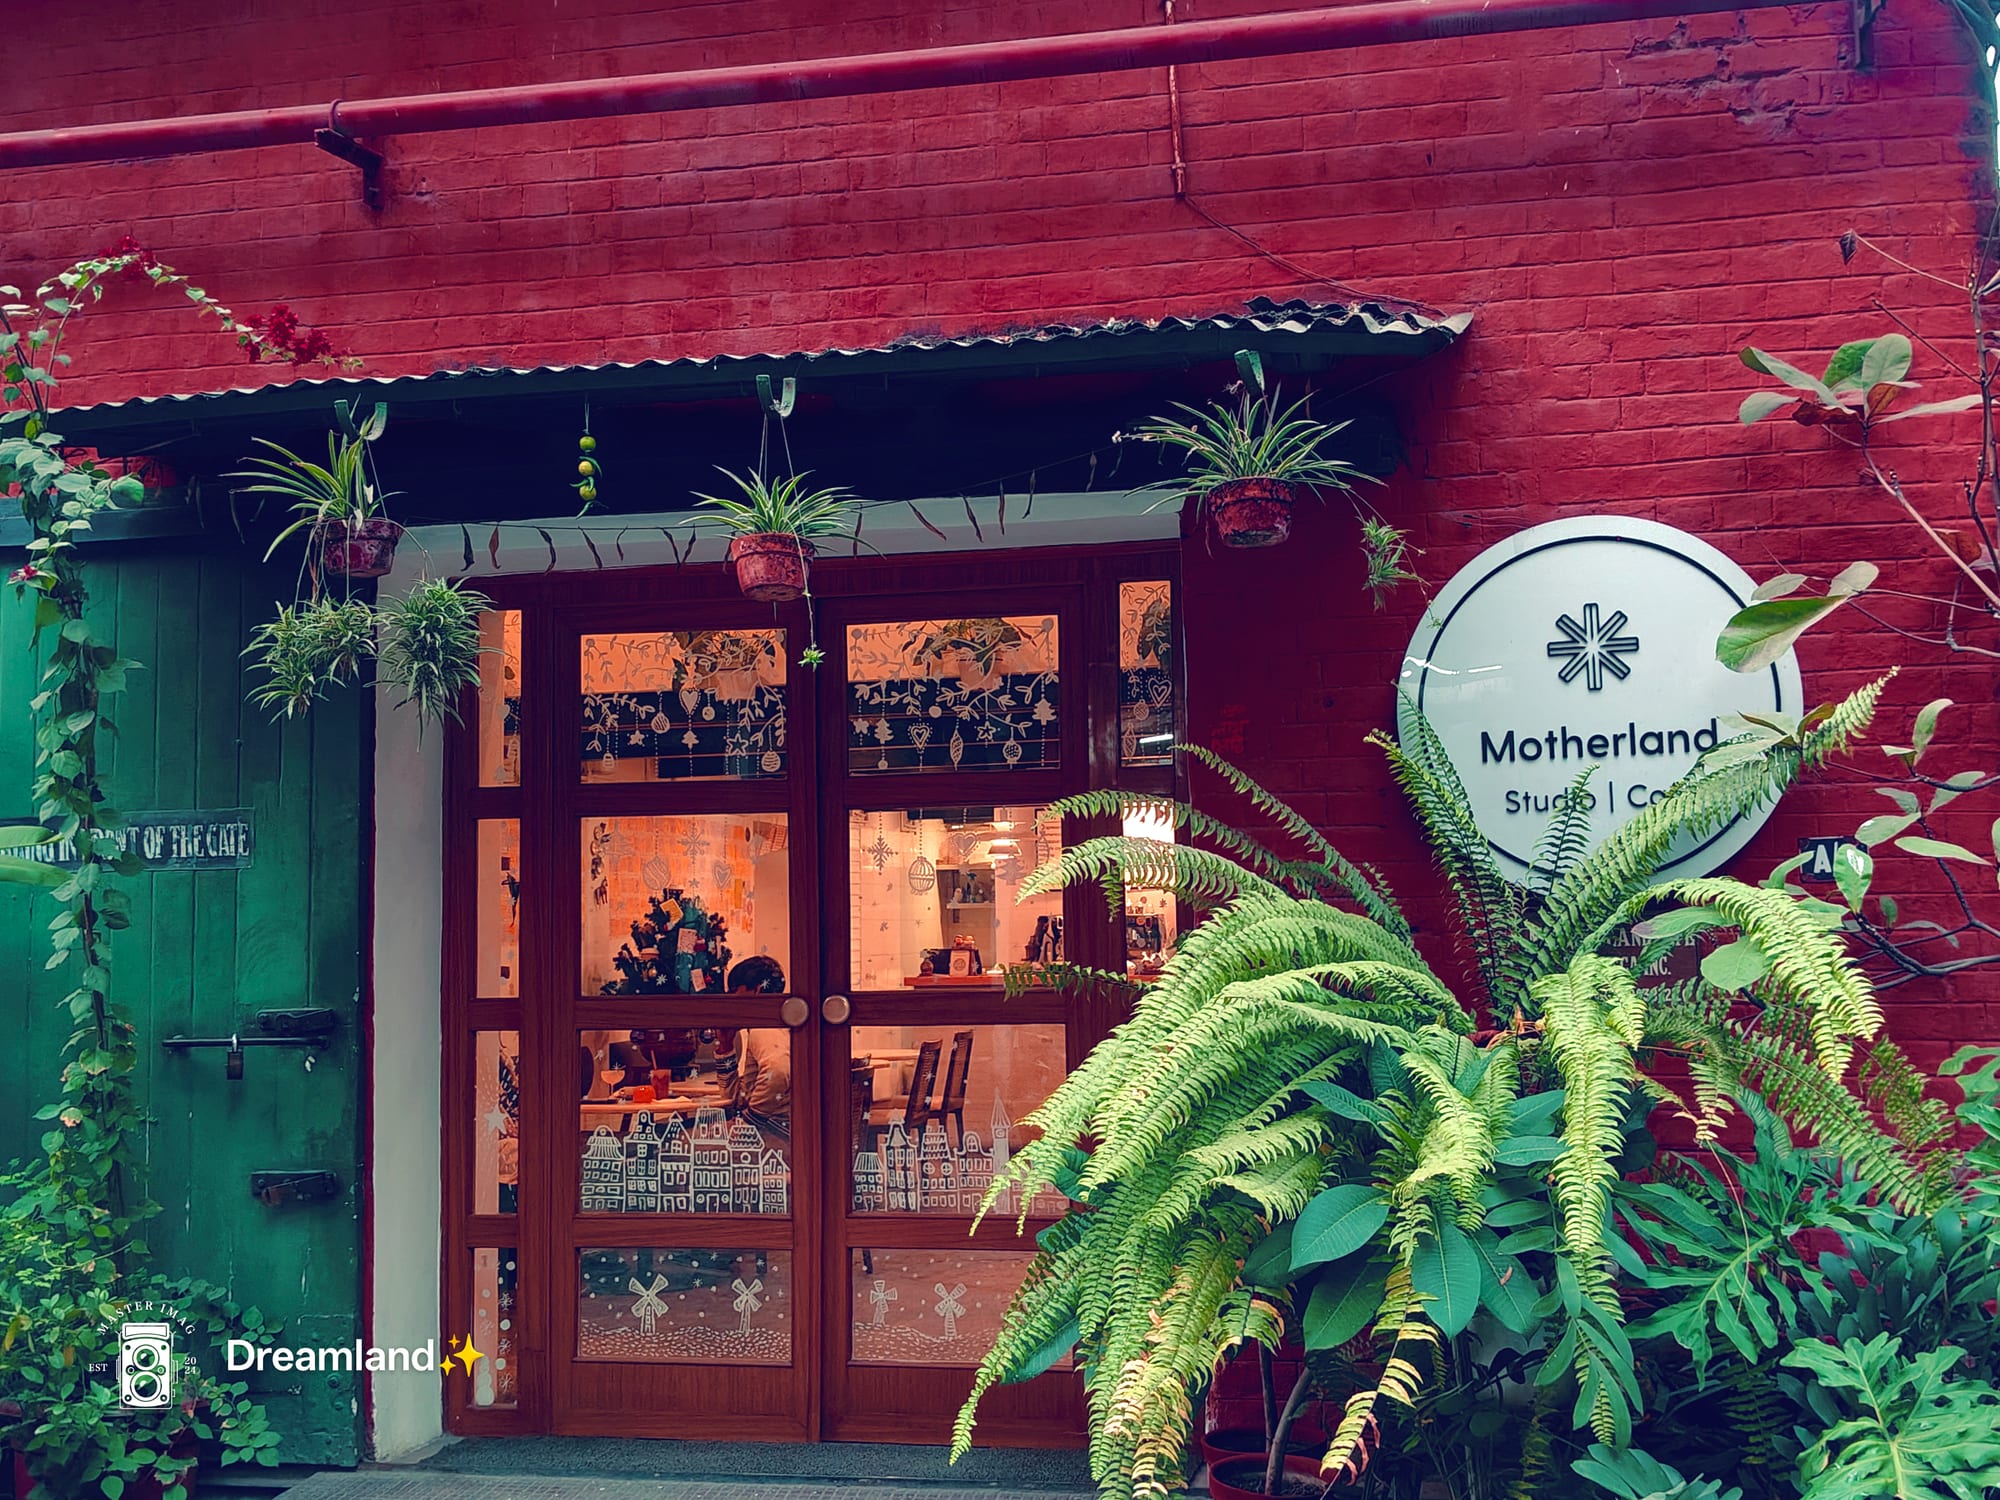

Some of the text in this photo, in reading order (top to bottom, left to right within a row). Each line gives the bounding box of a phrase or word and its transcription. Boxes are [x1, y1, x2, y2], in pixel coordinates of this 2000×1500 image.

[1480, 717, 1718, 764] Motherland
[1505, 787, 1597, 814] Studo
[143, 826, 166, 859] OF
[169, 824, 205, 858] THE
